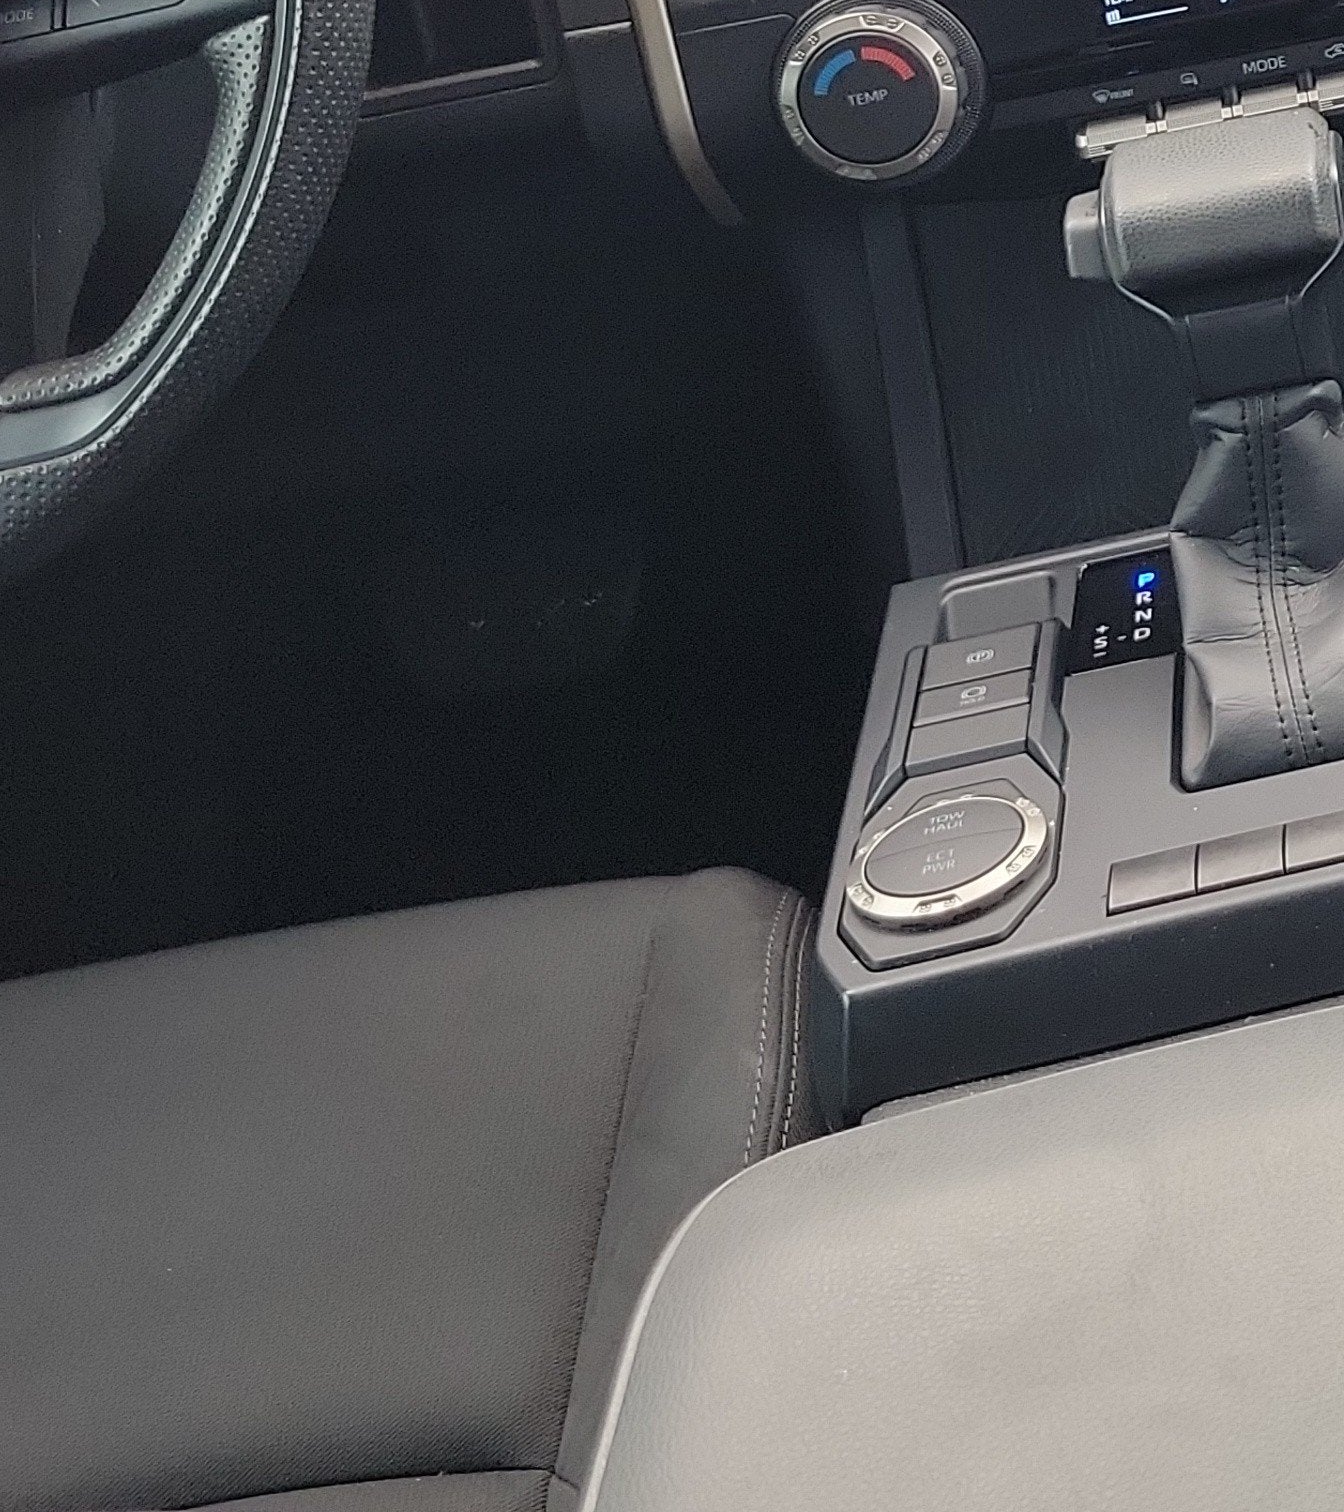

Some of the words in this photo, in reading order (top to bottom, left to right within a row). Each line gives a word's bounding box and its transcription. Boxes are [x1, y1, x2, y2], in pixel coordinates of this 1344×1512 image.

[1241, 55, 1288, 75] MODE
[847, 88, 889, 107] TEMP
[1138, 572, 1155, 588] P
[1135, 591, 1153, 606] R
[1134, 608, 1152, 623] N
[1094, 635, 1108, 649] S
[1133, 627, 1151, 642] D
[930, 810, 965, 825] TOW
[924, 819, 963, 835] HAUL
[922, 858, 956, 874] PWR
